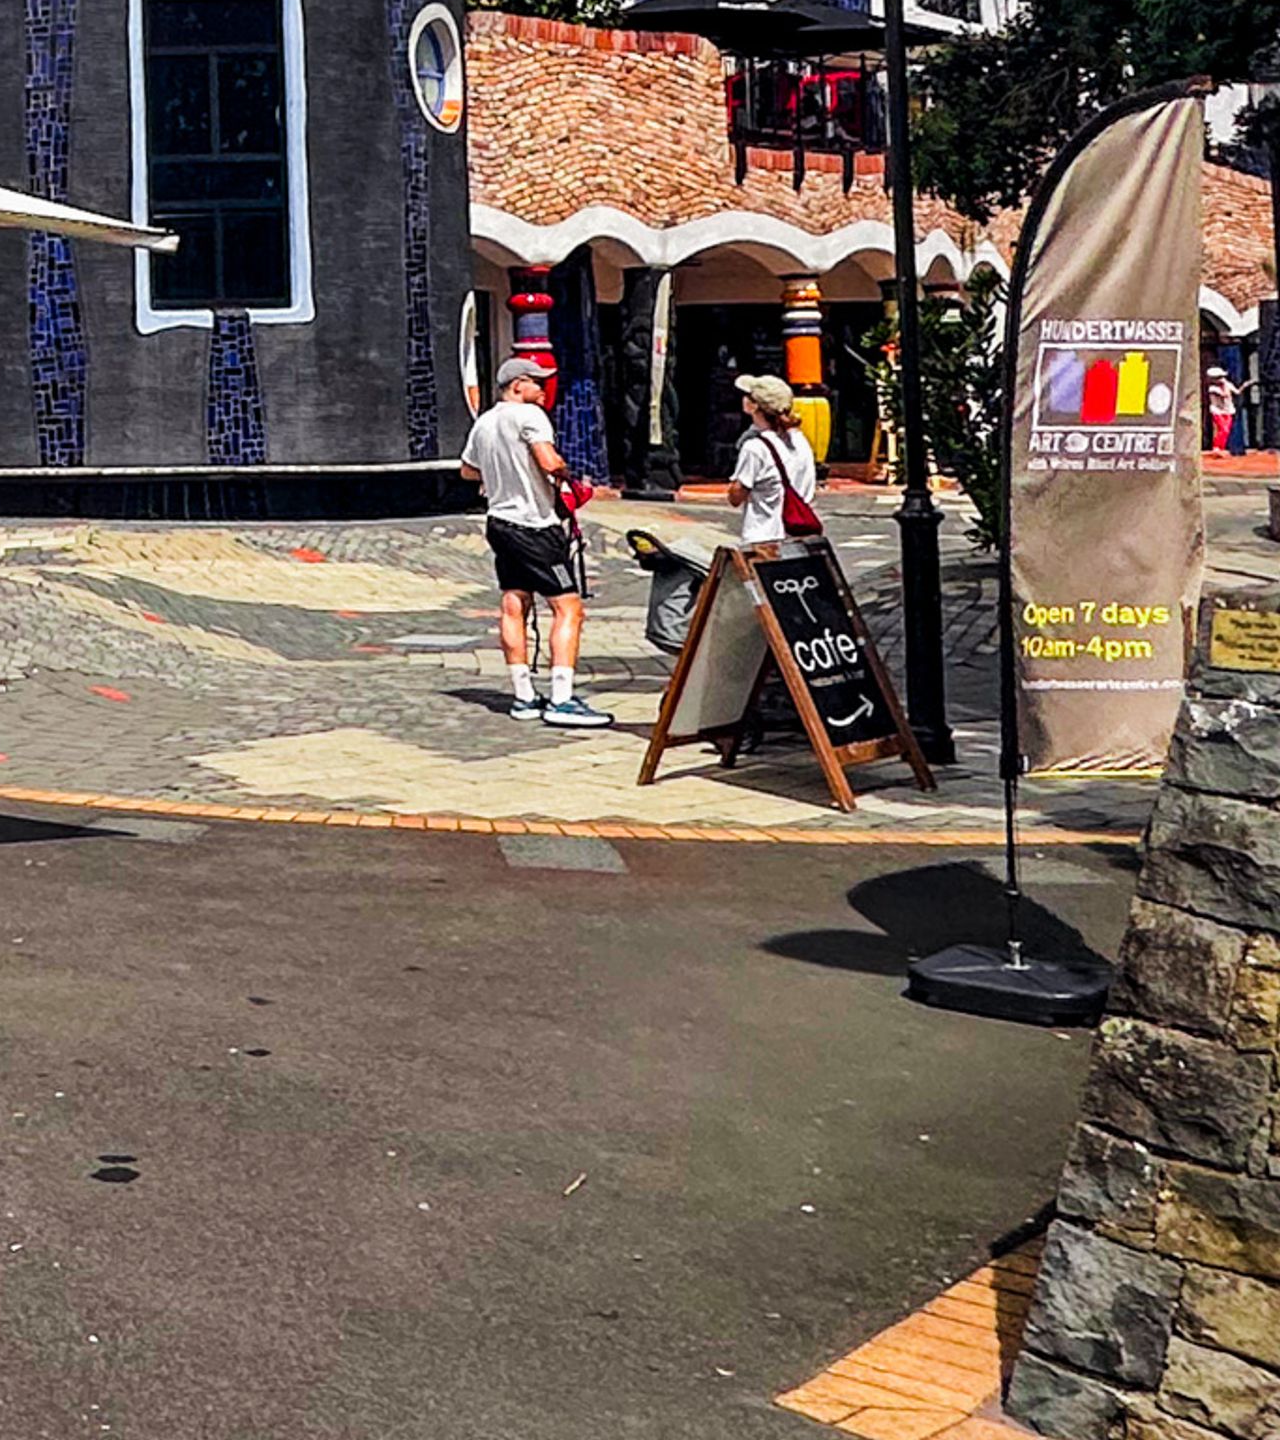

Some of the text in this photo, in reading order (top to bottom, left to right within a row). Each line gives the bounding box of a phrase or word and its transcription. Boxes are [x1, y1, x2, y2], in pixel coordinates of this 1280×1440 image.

[1041, 319, 1184, 341] HUNDERTWASSER
[1029, 433, 1156, 454] ART CENTRE
[1023, 601, 1171, 629] Open 7 days
[793, 627, 858, 672] cafe
[1022, 635, 1154, 663] 10am-4pm
